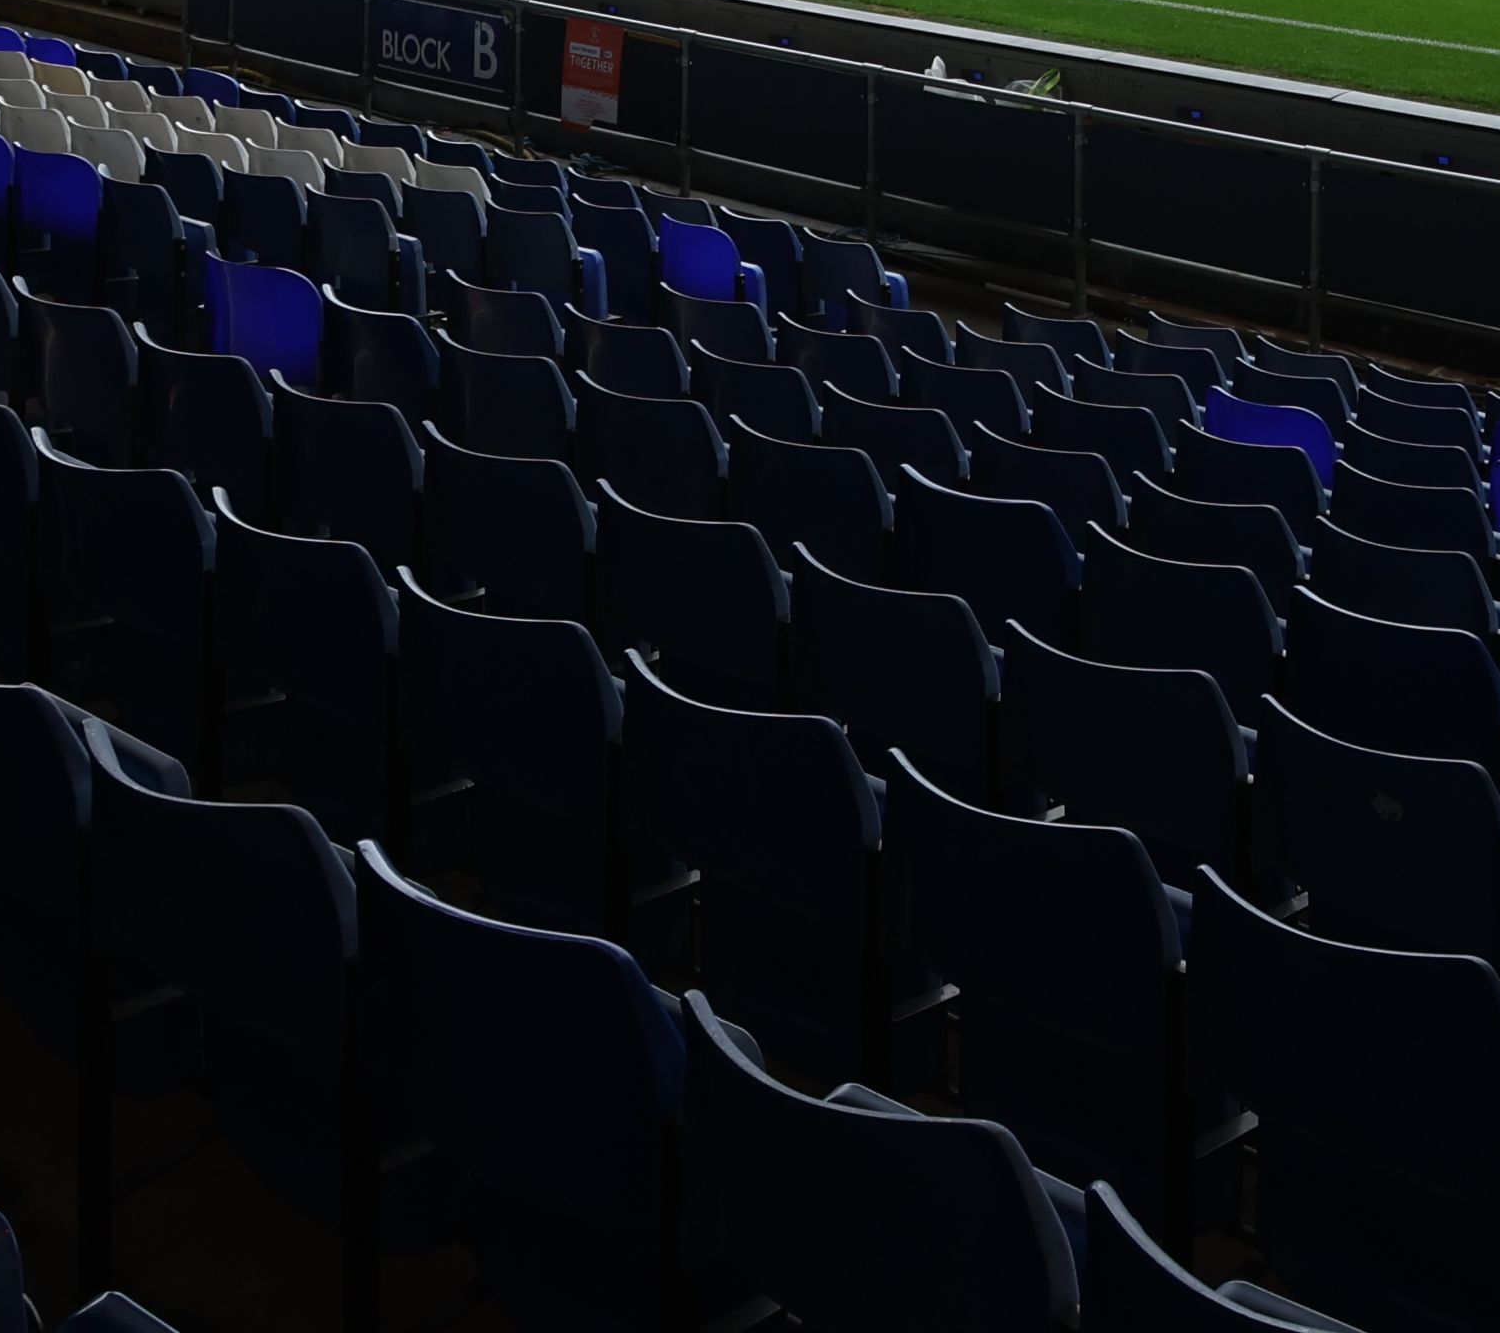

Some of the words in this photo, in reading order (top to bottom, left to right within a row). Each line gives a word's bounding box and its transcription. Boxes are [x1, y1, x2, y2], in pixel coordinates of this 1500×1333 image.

[382, 29, 451, 72] BLOCK
[474, 20, 498, 79] B
[570, 55, 614, 74] TOGETHER
